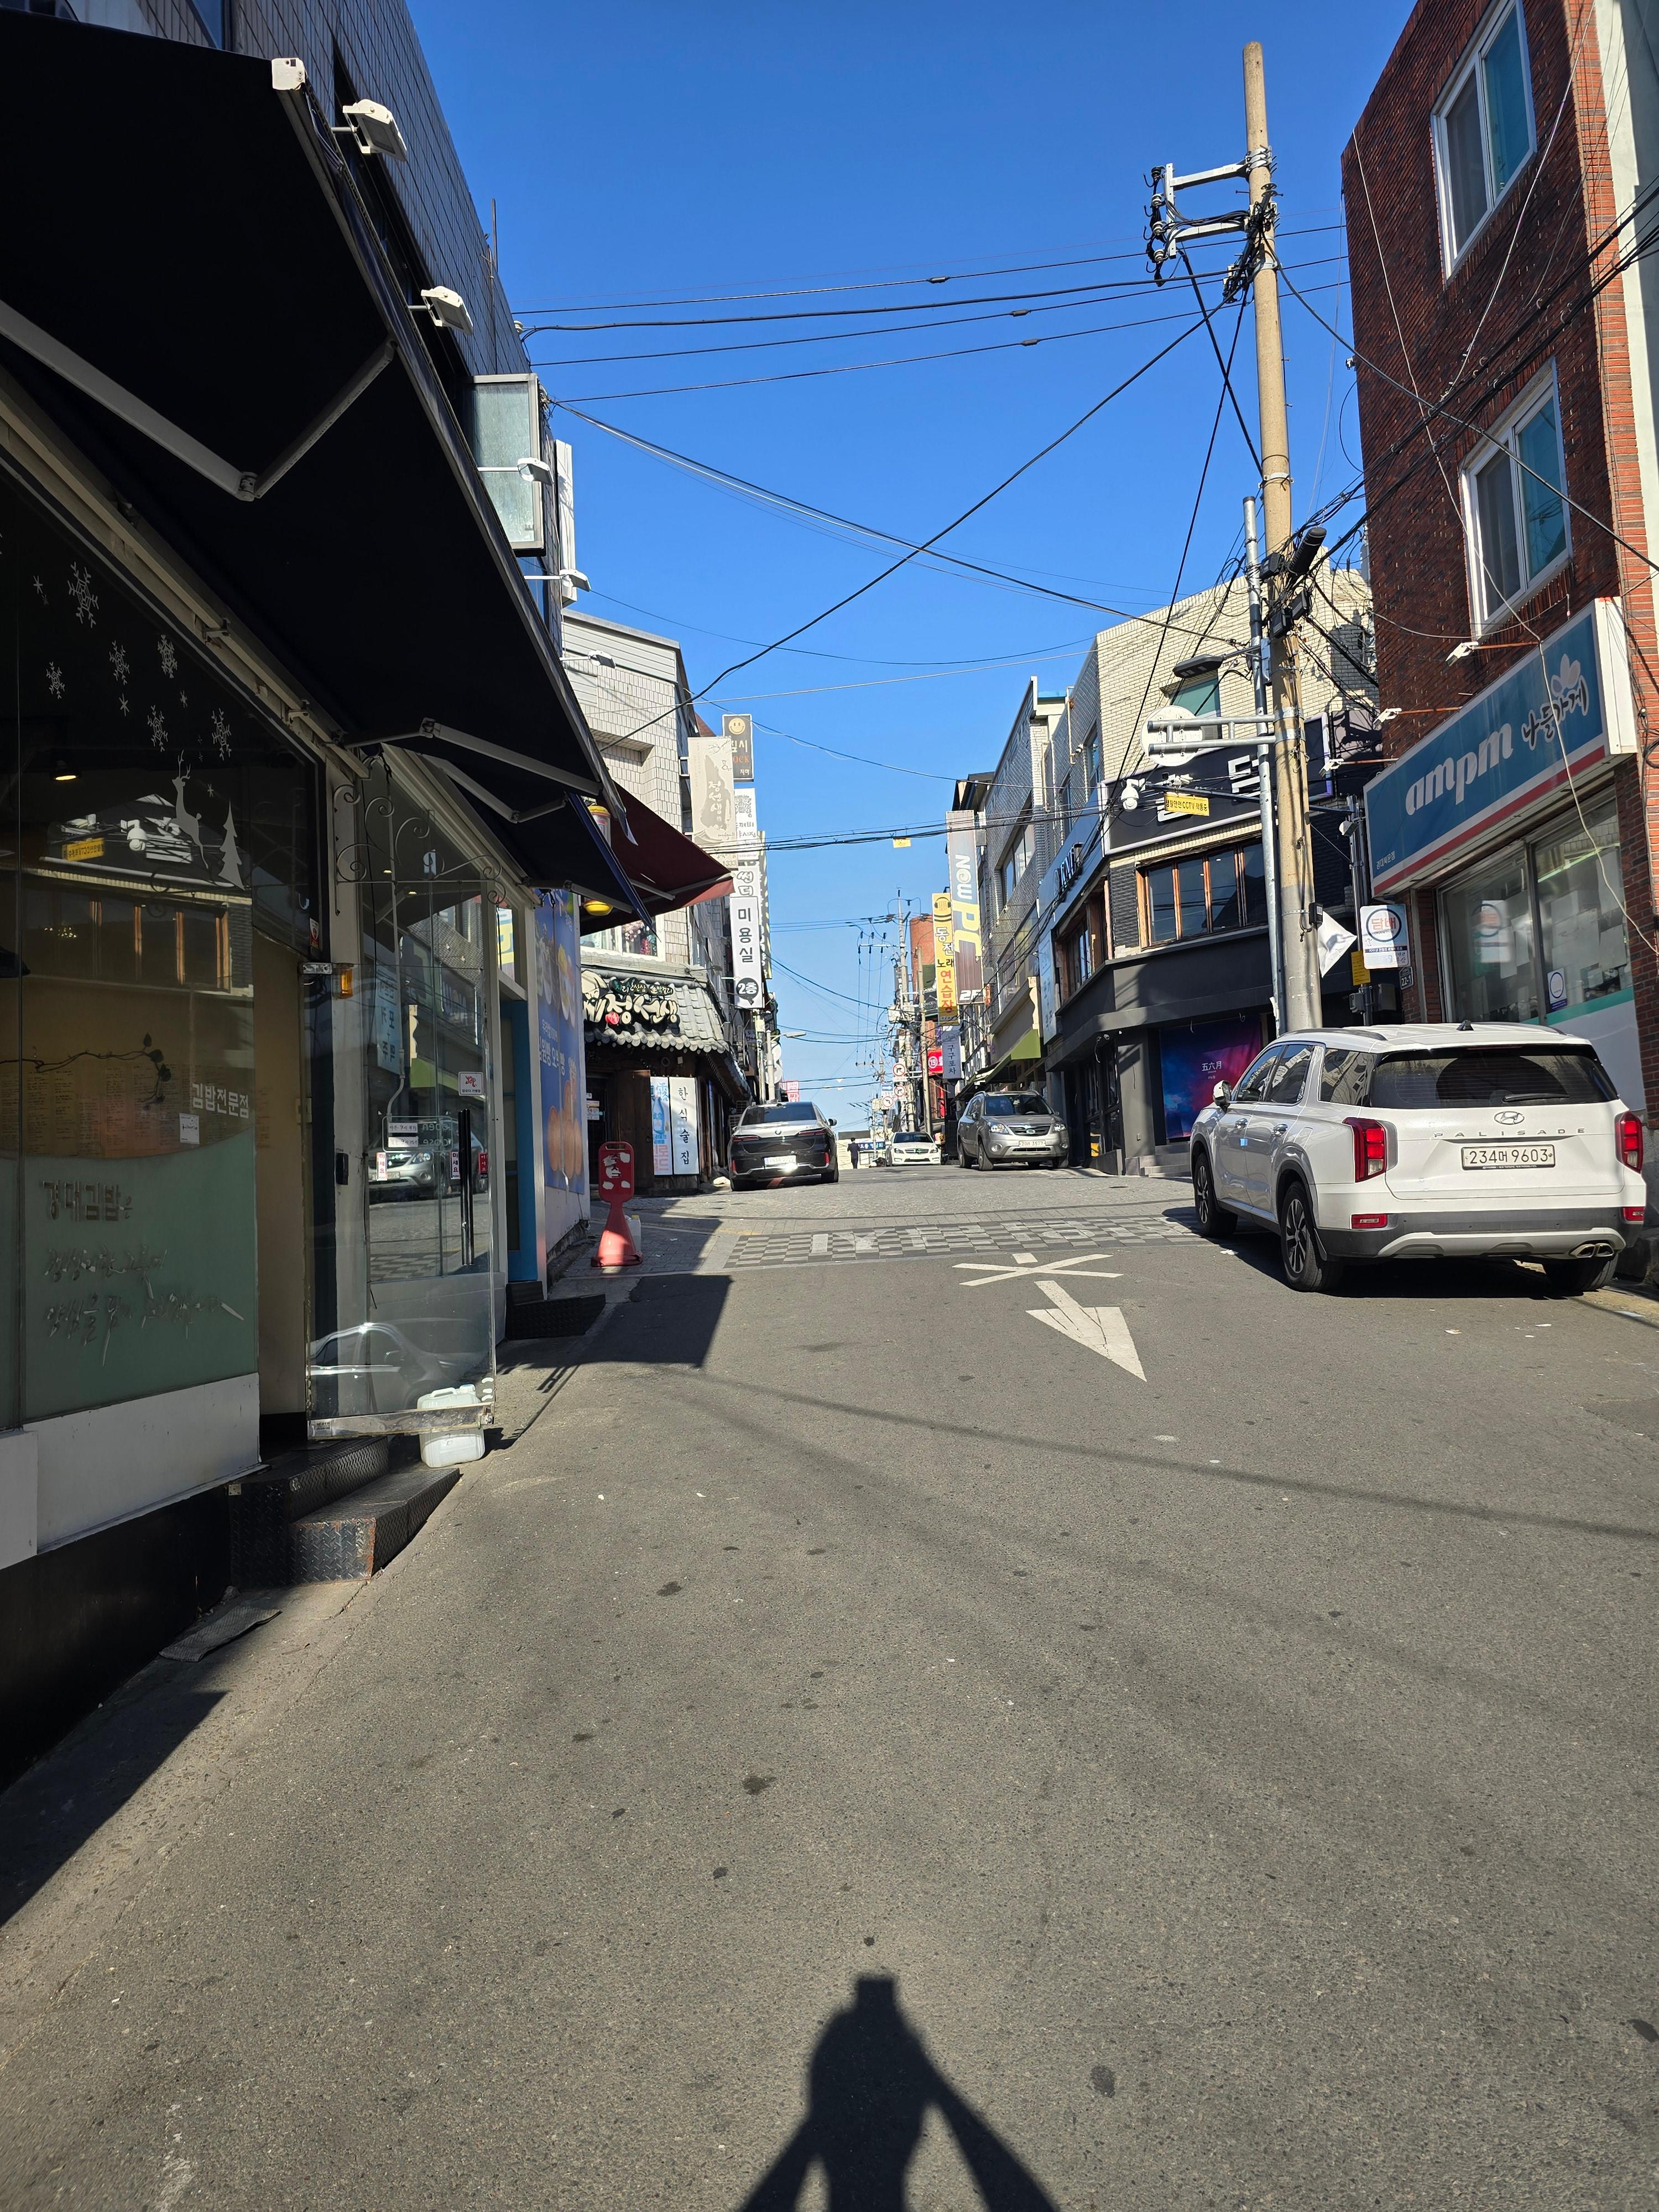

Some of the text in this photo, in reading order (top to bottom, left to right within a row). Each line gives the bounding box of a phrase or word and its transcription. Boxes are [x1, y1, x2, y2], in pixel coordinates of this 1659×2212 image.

[1405, 723, 1514, 816] ampm
[738, 907, 753, 963] 미용실
[952, 899, 983, 957] PC
[1371, 917, 1396, 930] 담배
[937, 958, 954, 968] 노래
[737, 982, 757, 995] 2층
[940, 969, 954, 1013] 연습장
[1401, 975, 1411, 987] 22-1
[605, 994, 678, 1024] 정선생
[947, 1045, 957, 1074] 구구포차
[1201, 1061, 1222, 1071] 五六月
[192, 1082, 249, 1119] 김밥전문점
[678, 1087, 690, 1165] 한식술집
[1433, 1128, 1586, 1138] PALISADE
[1511, 1149, 1548, 1163] 9603
